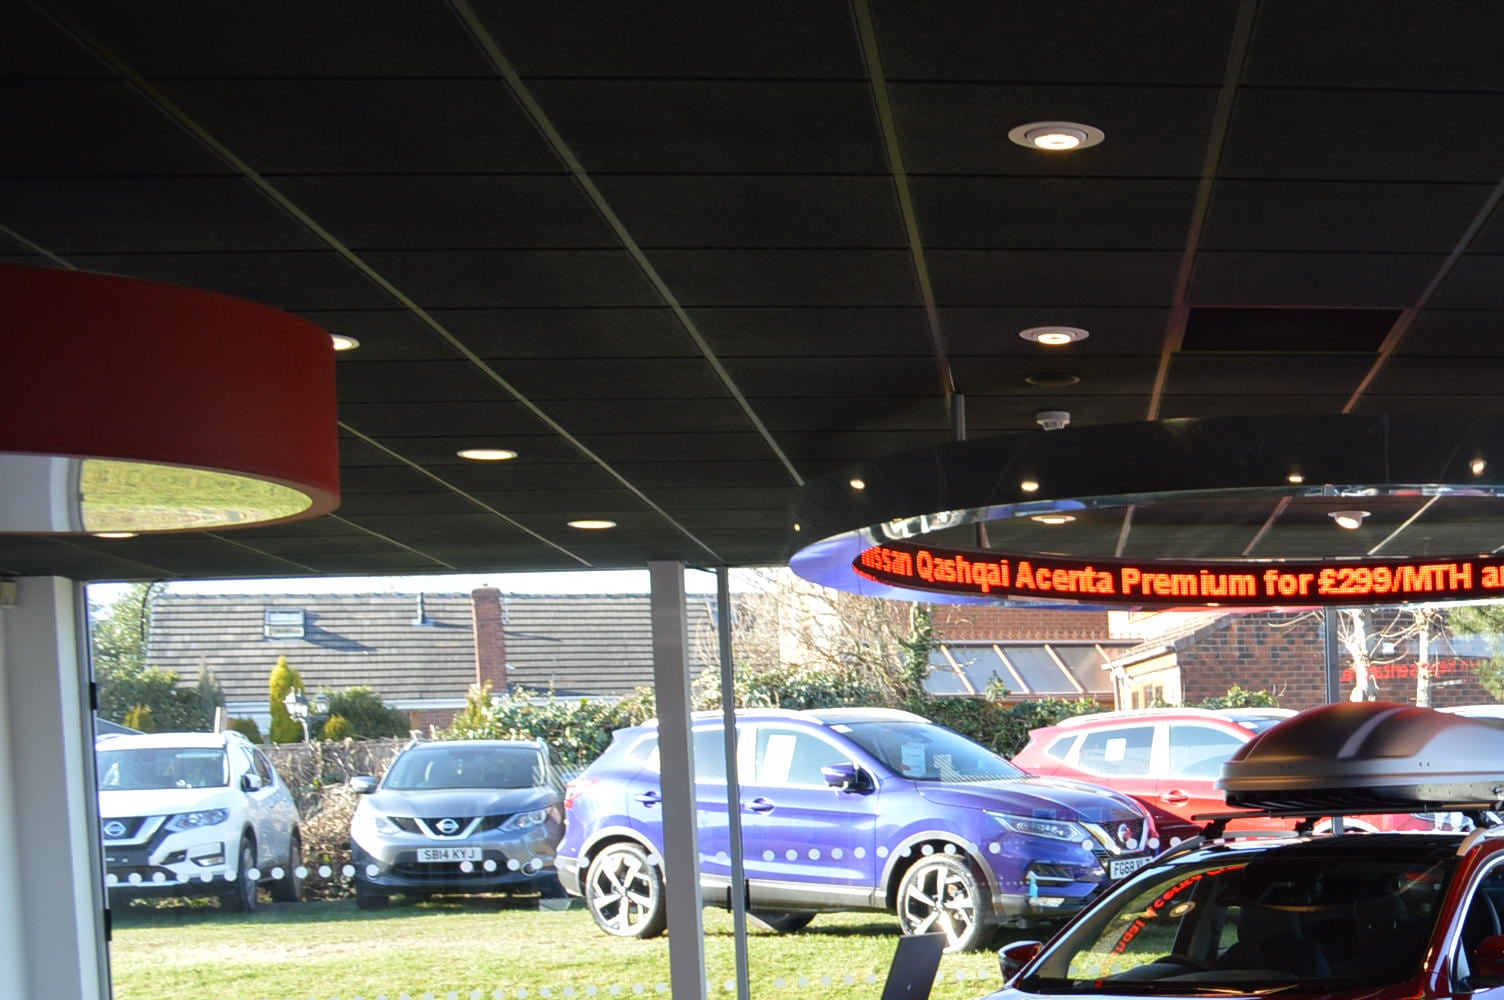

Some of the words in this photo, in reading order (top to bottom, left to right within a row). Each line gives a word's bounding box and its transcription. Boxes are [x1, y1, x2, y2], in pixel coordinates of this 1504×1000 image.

[916, 550, 1010, 593] Qashqai
[1015, 561, 1115, 594] Acenta
[1121, 567, 1257, 596] Premium
[1264, 569, 1311, 596] for
[1317, 563, 1472, 595] £299/MTH
[424, 849, 449, 860] SB14
[452, 848, 475, 859] KYJ
